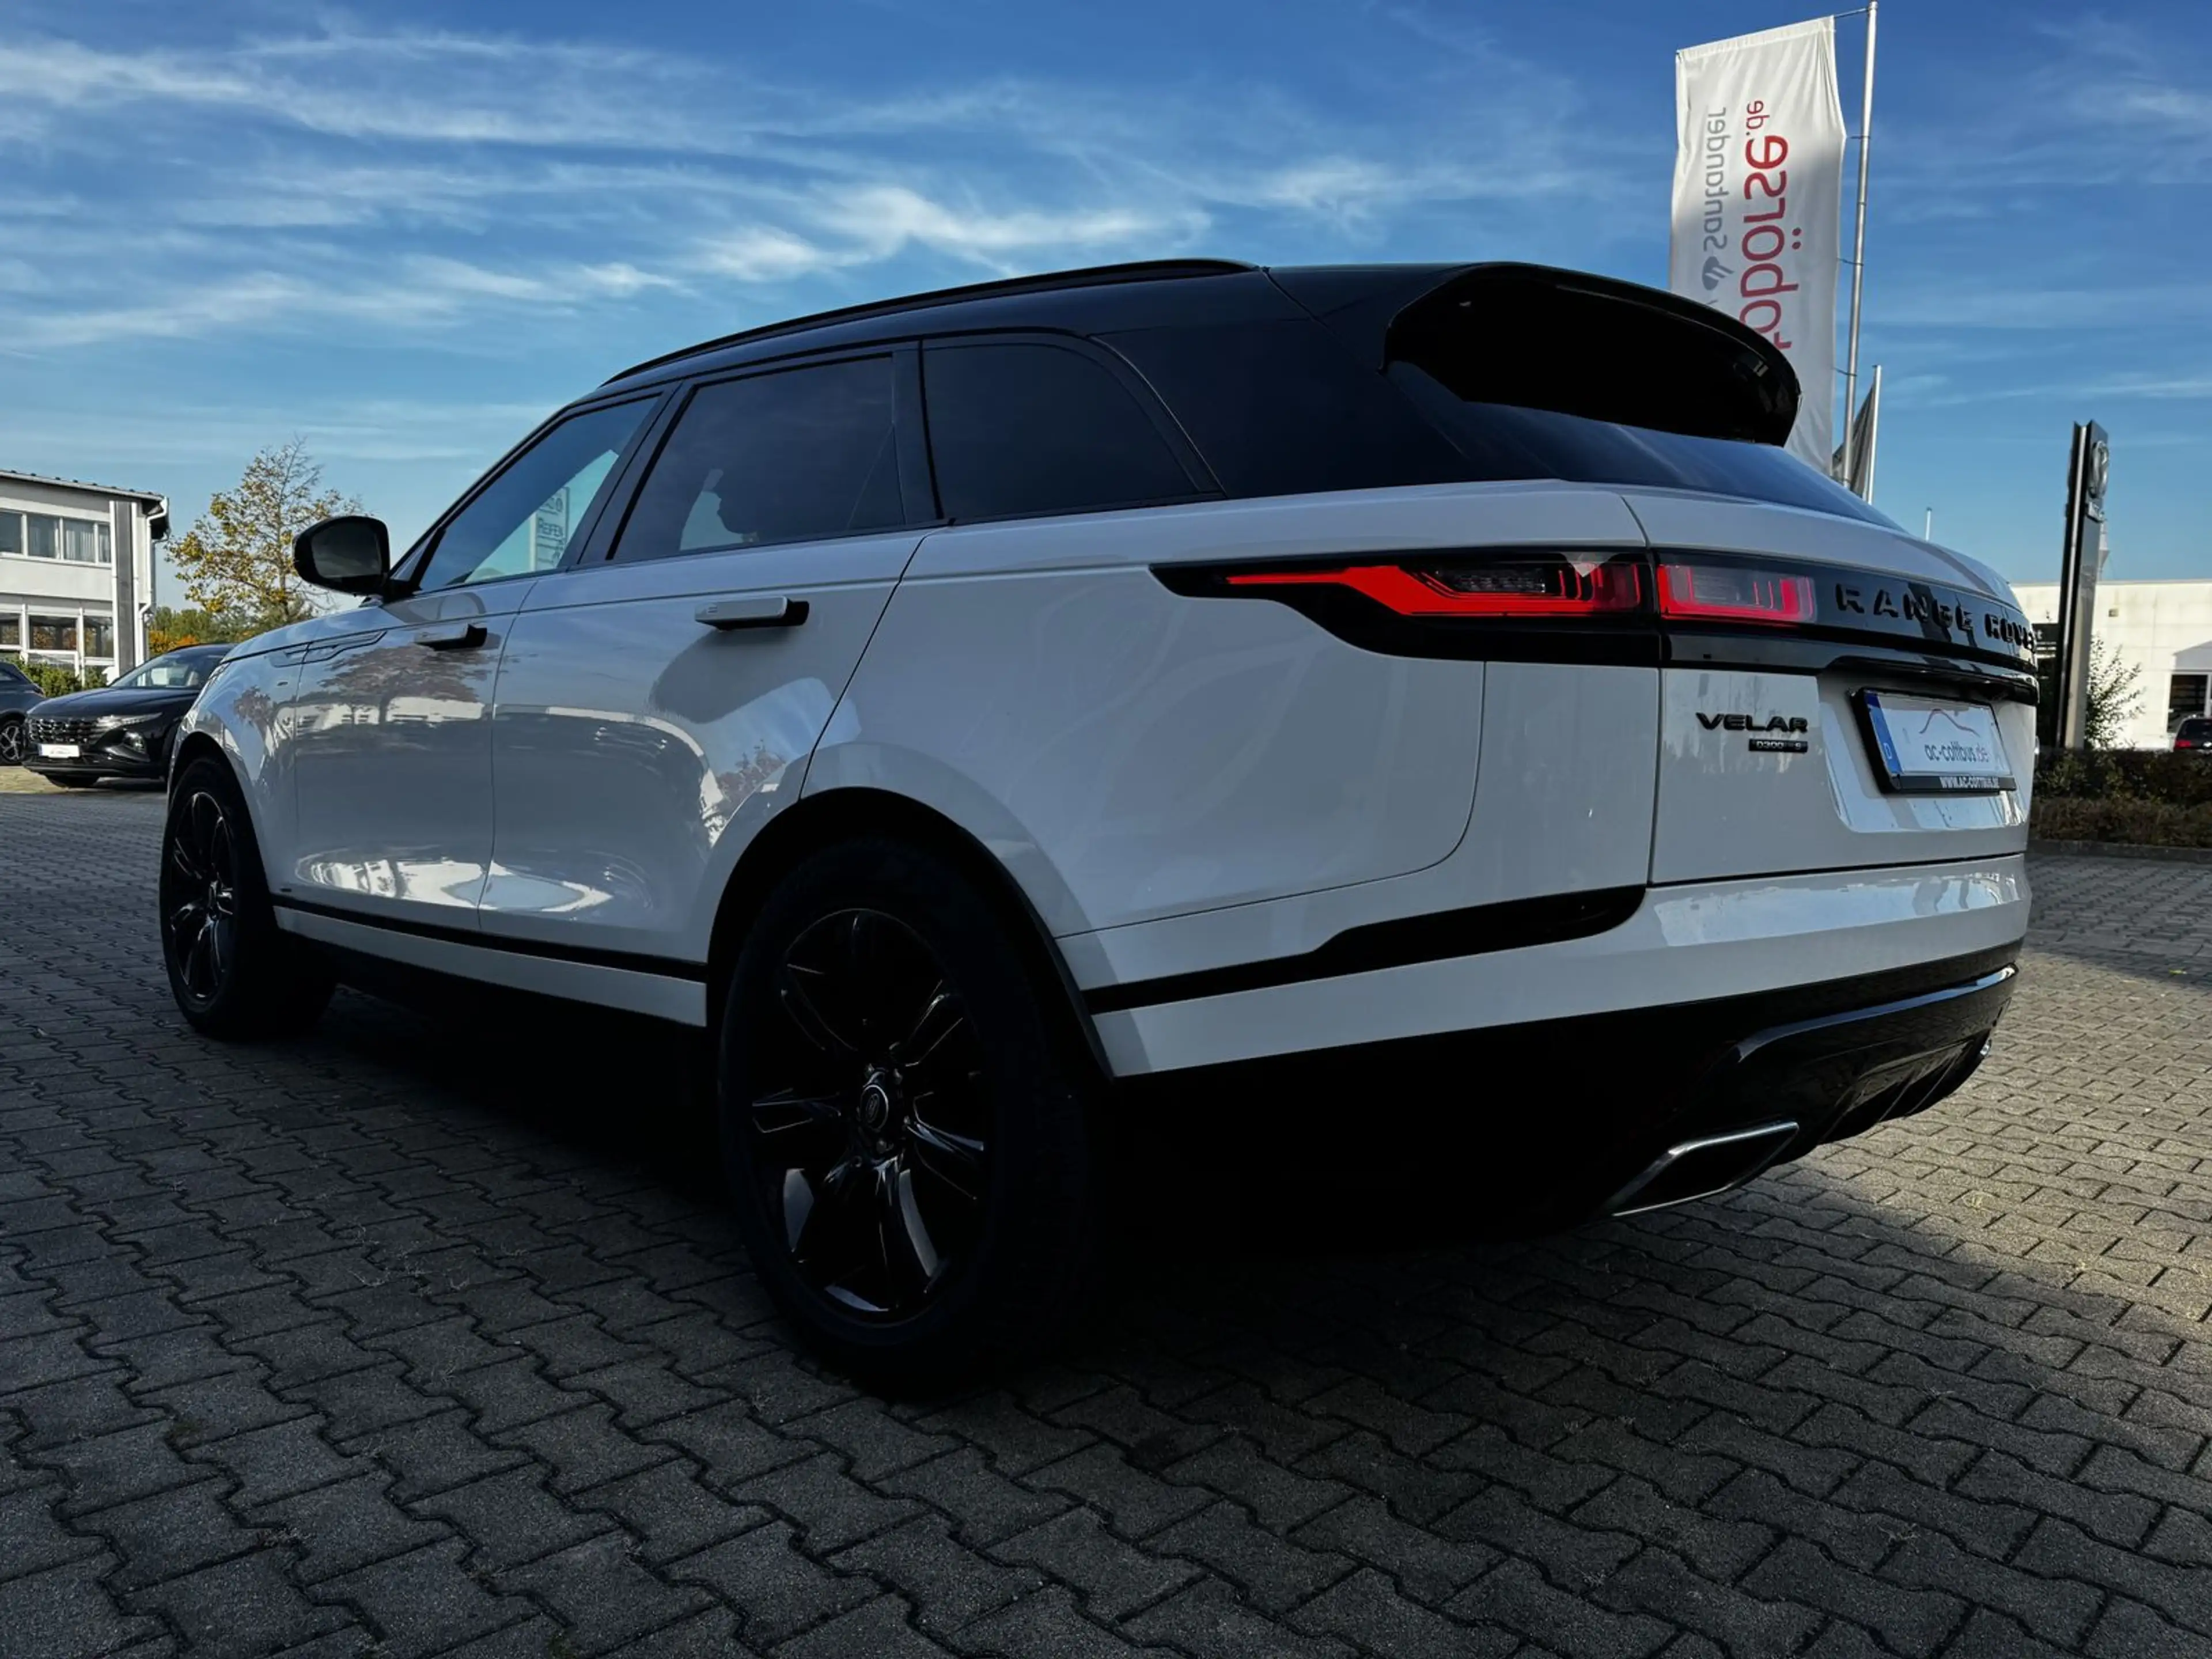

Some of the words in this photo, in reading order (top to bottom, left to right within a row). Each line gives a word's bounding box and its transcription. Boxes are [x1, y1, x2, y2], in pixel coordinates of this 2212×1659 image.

[1835, 583, 1974, 631] RANGE
[1695, 712, 1808, 733] VELAR
[1883, 743, 1892, 760] D
